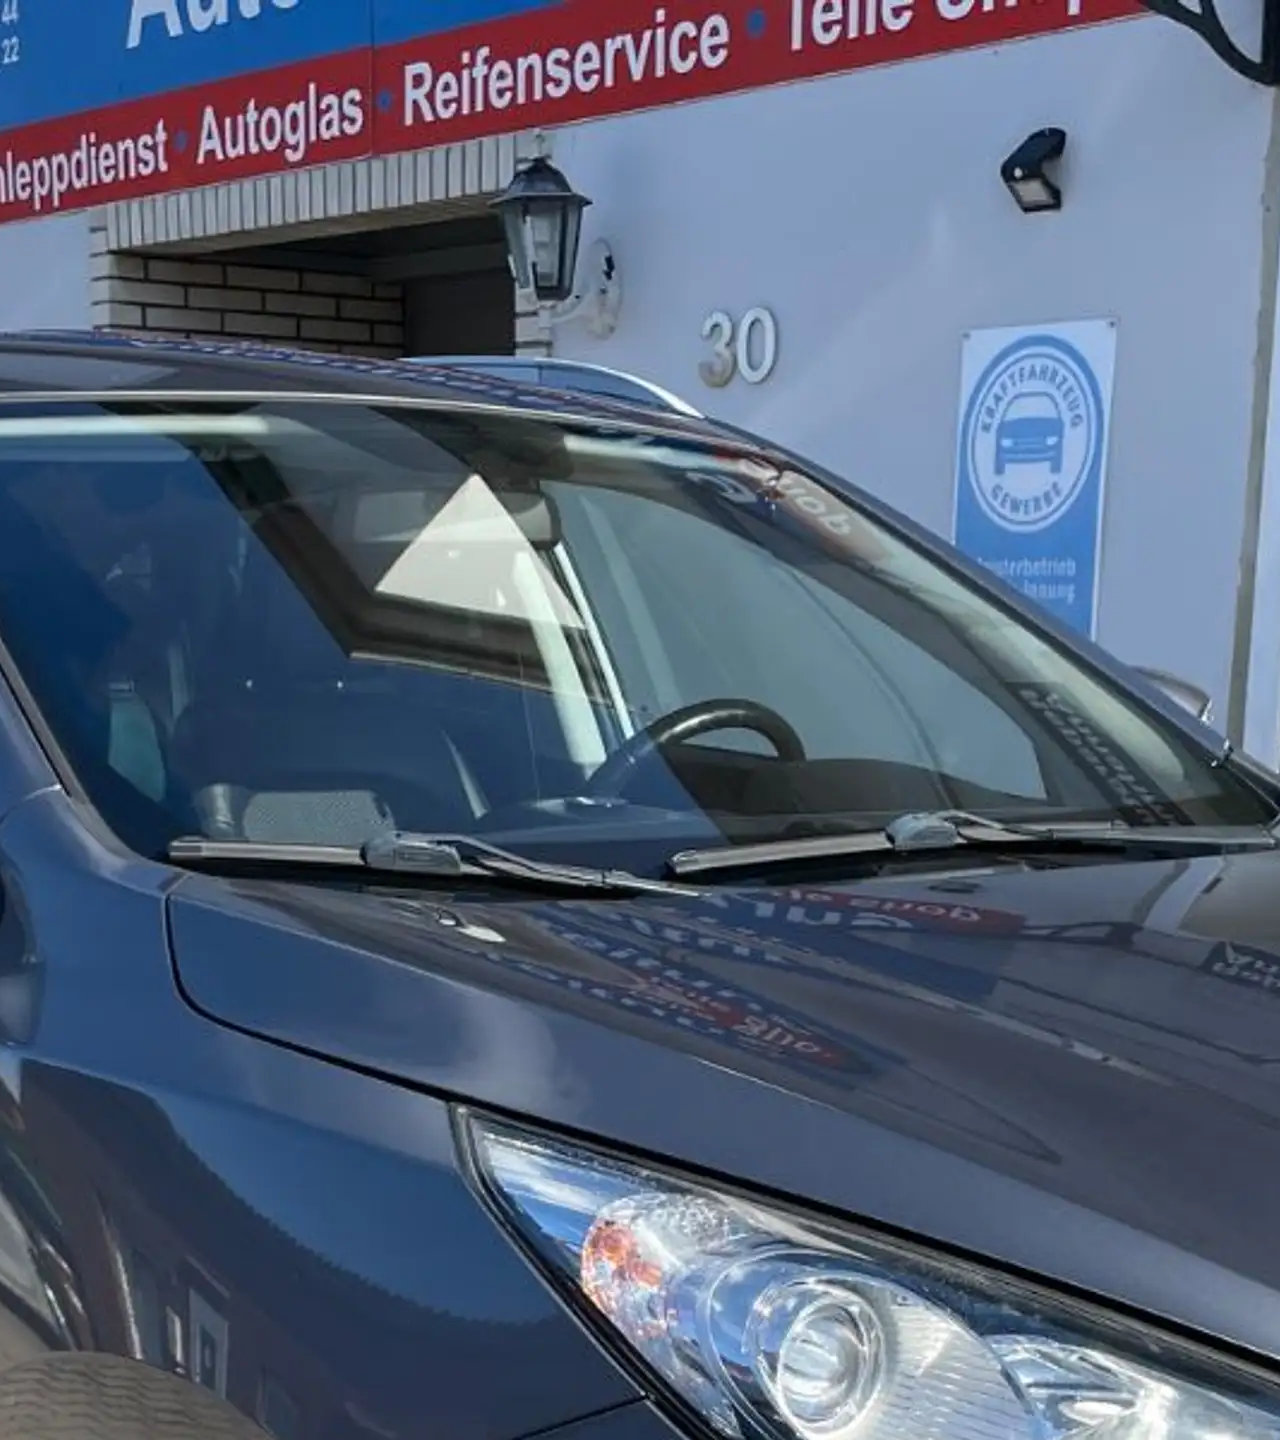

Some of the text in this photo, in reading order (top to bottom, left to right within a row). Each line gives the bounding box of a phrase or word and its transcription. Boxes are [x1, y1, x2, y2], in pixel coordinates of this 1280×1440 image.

[1, 36, 20, 63] 22
[196, 81, 364, 164] Autoglas
[403, 9, 731, 127] Reifenservice
[697, 306, 779, 389] 30
[980, 362, 1084, 435] KRAFTFAHRZEUG
[990, 480, 1063, 517] GEWERBE
